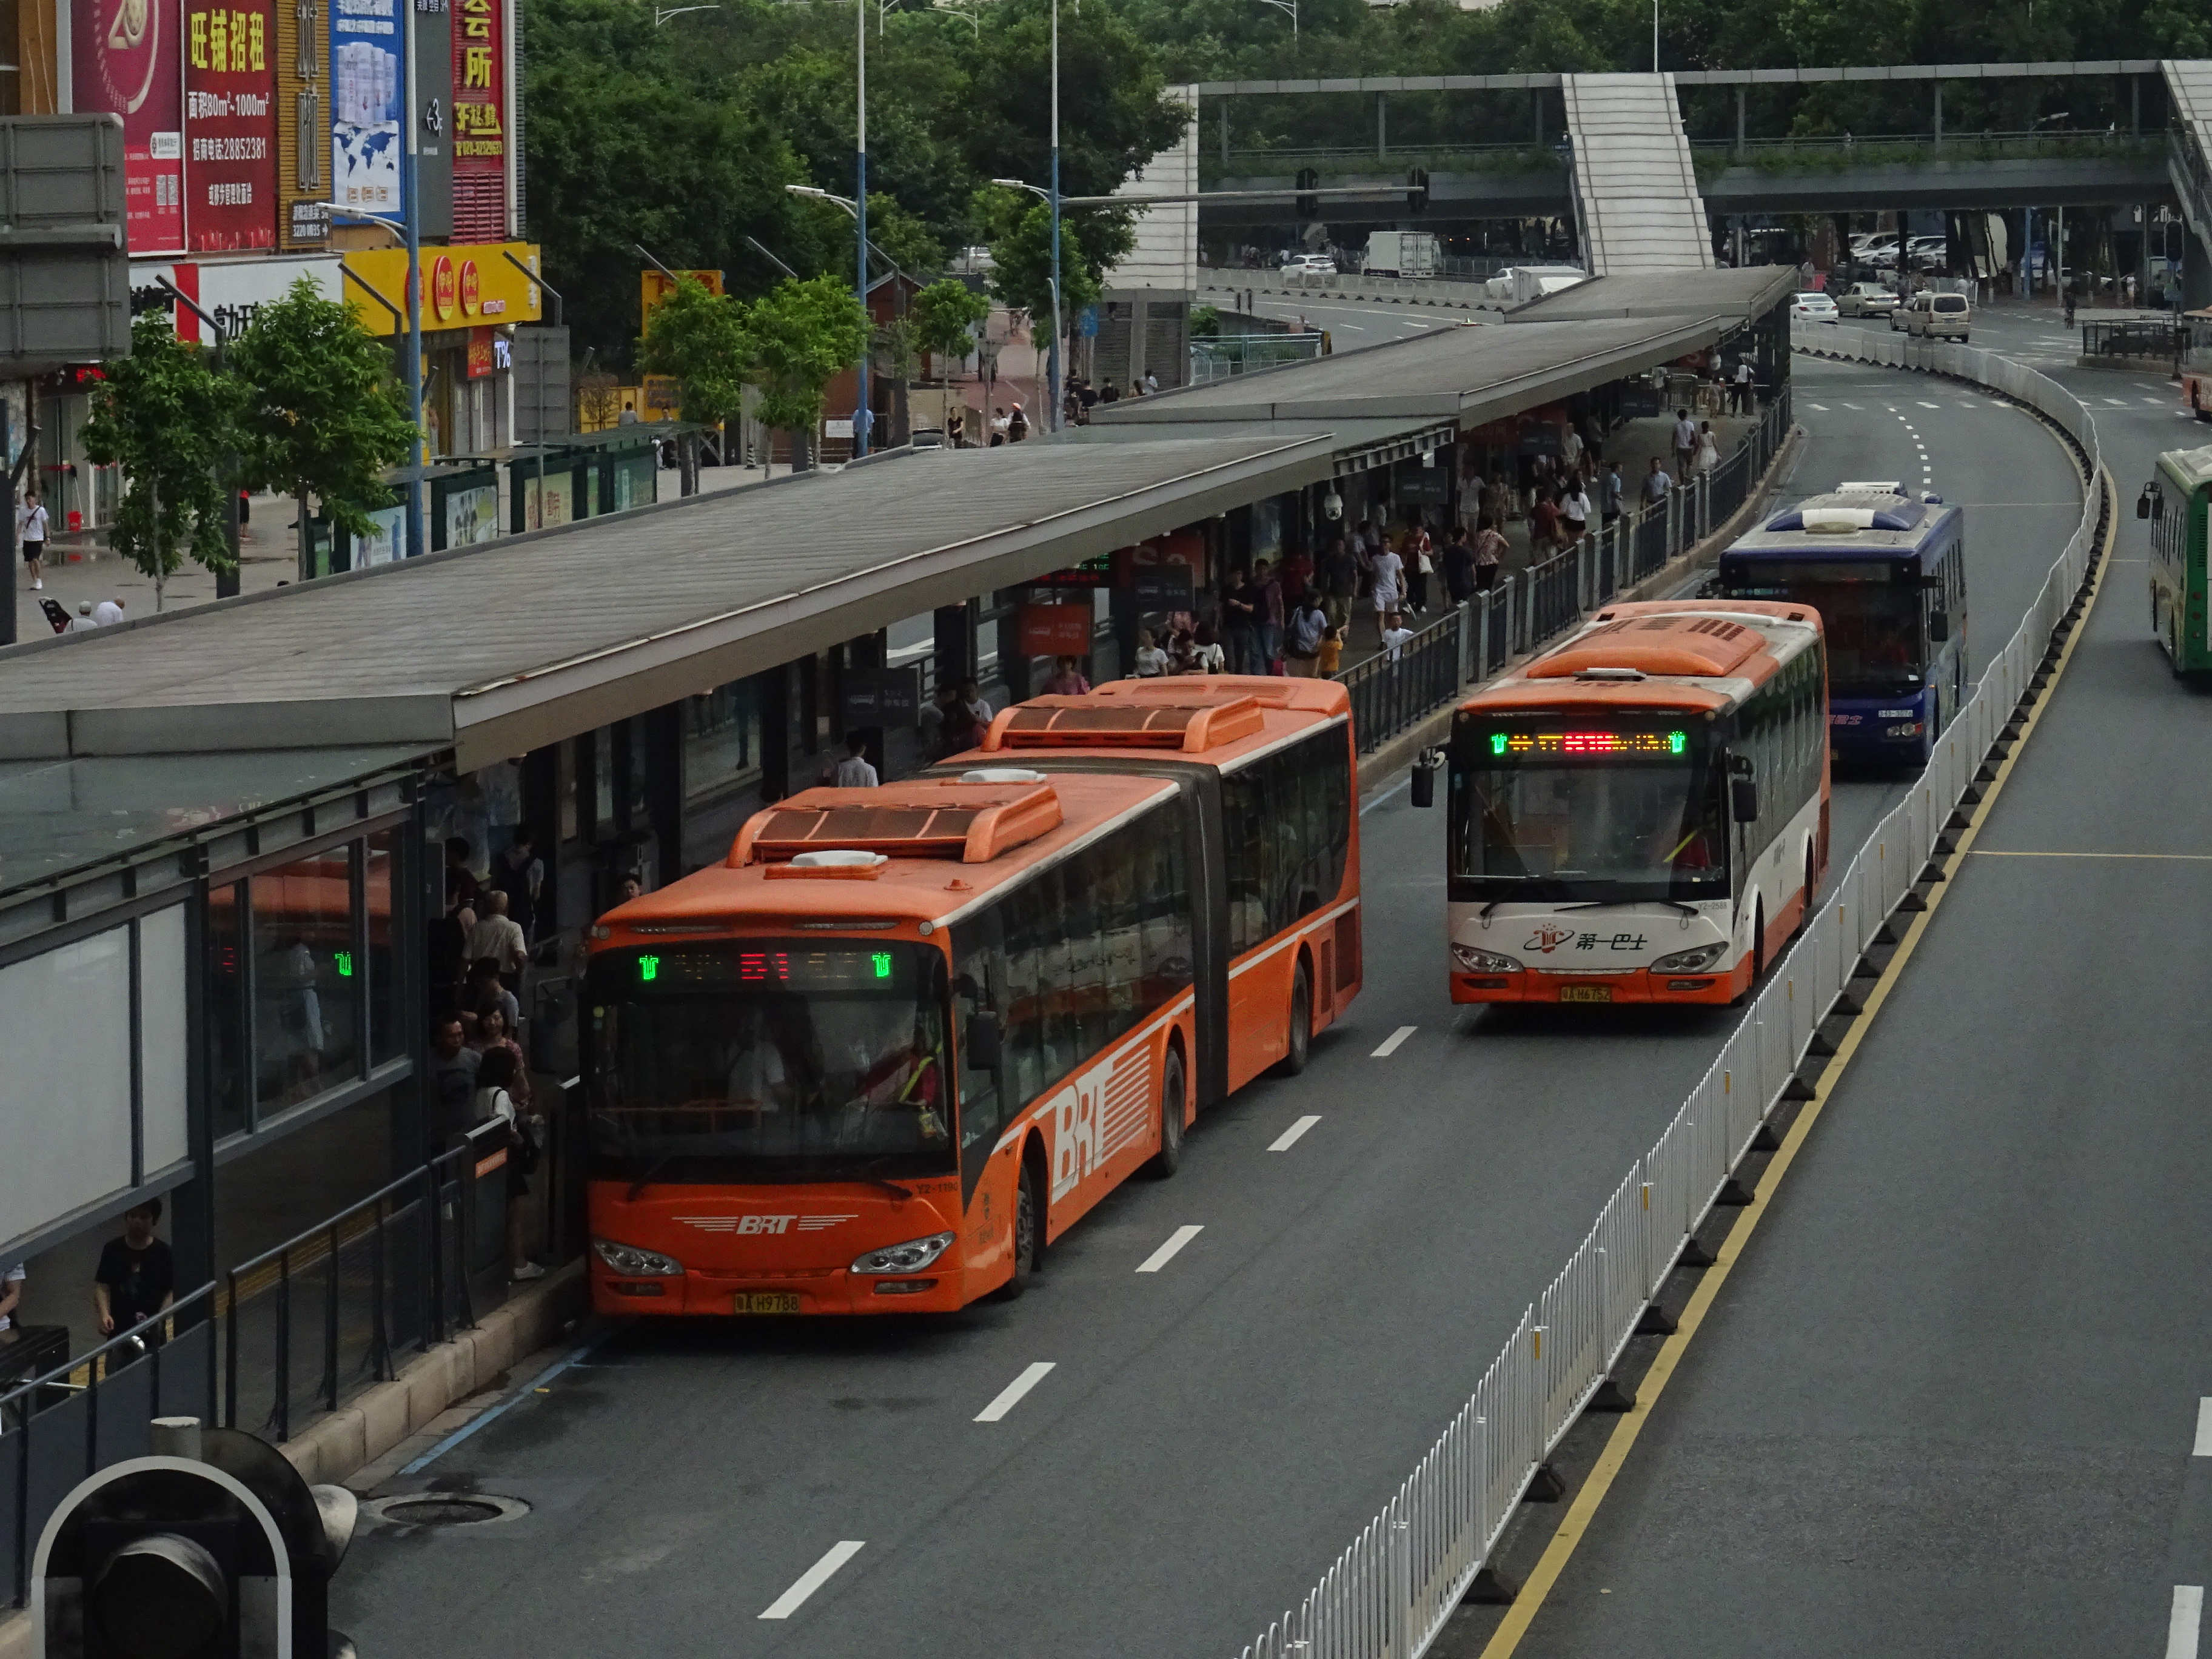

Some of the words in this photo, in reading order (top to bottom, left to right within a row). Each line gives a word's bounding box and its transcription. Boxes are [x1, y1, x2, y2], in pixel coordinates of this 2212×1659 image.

[190, 8, 266, 73] 旺铺招租
[1576, 933, 1648, 951] 第一巴士
[1052, 1059, 1114, 1205] BRT
[736, 1215, 797, 1235] BRT
